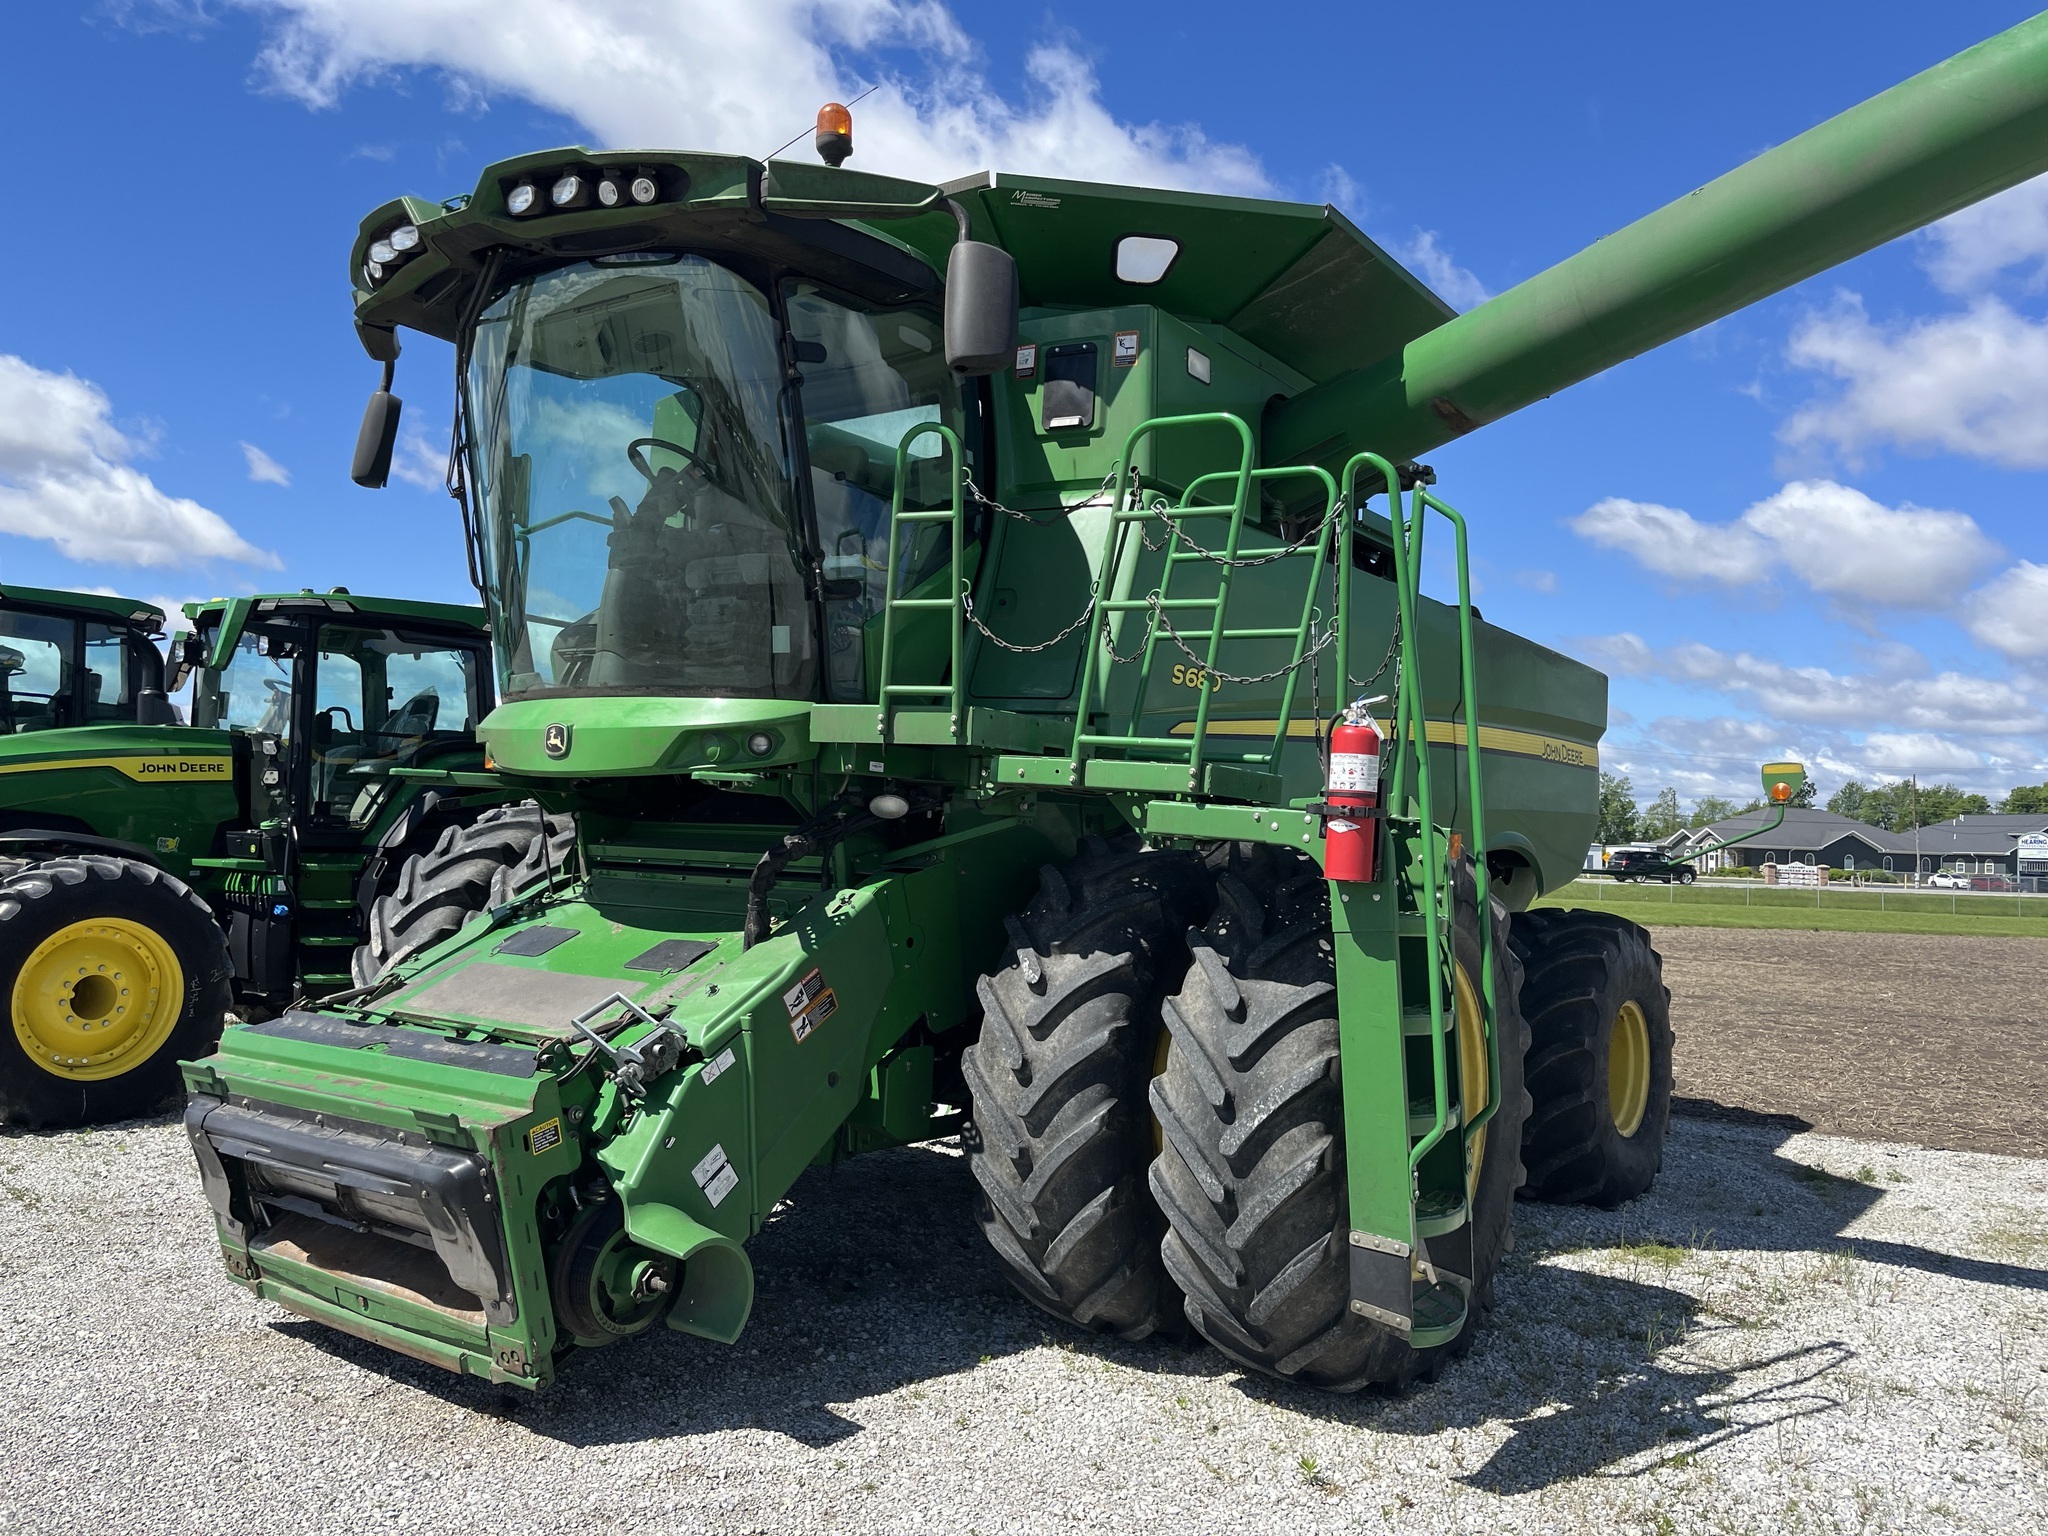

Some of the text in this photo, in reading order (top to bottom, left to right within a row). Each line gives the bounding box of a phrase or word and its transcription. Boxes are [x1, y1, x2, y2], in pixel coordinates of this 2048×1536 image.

[1541, 740, 1584, 765] JOHN DEERE
[138, 762, 225, 773] JOHN DEERE
[535, 1119, 558, 1133] CAUTION
